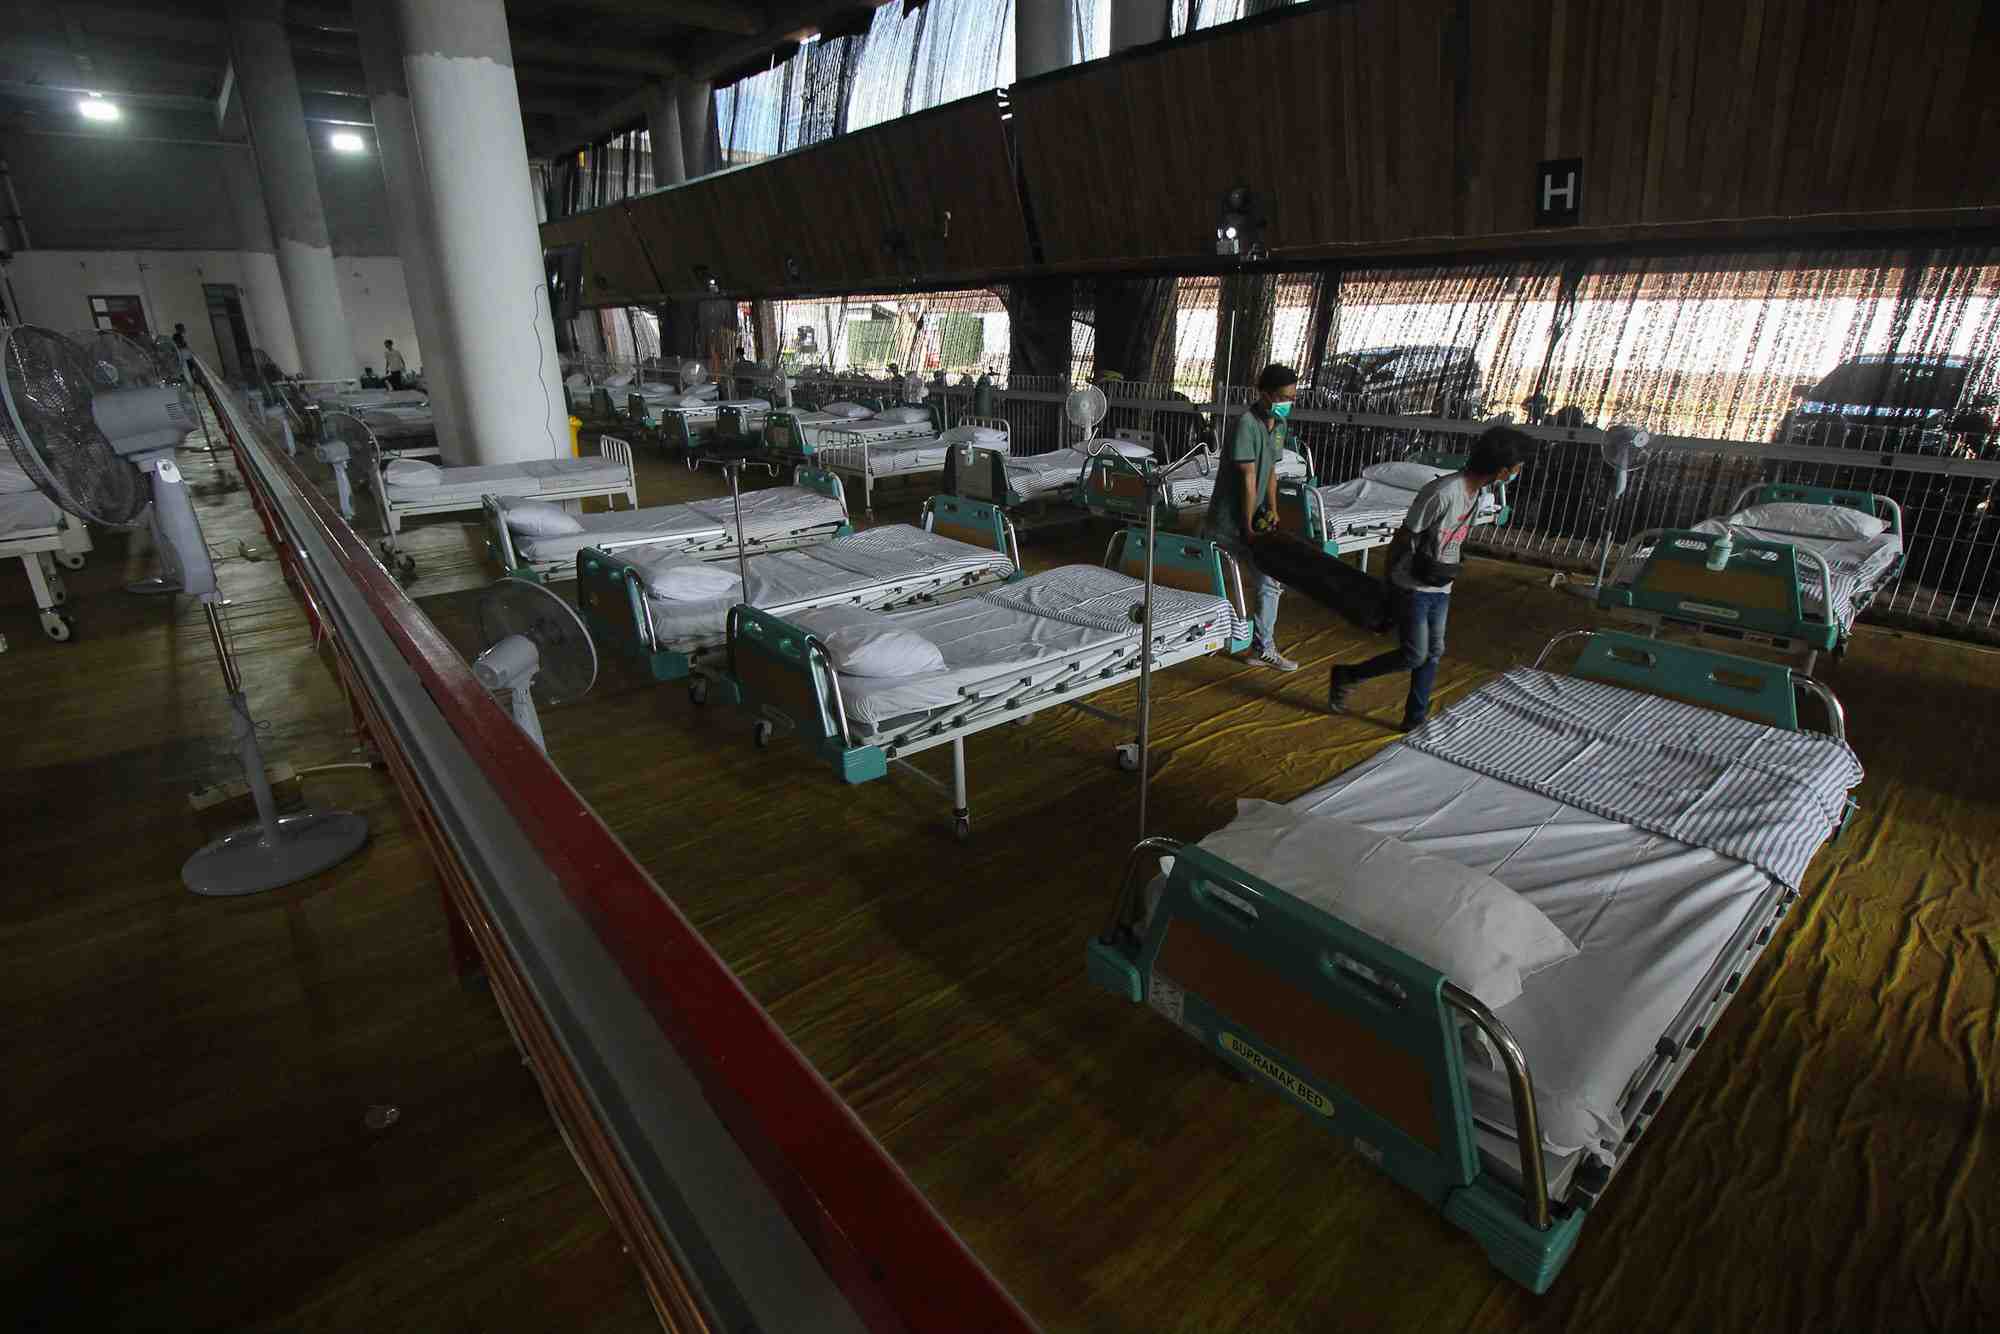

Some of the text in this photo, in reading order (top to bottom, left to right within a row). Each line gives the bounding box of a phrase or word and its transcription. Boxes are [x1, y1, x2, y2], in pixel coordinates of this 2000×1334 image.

[1544, 172, 1575, 210] H
[1232, 1039, 1323, 1108] SUPRAMAK BED
